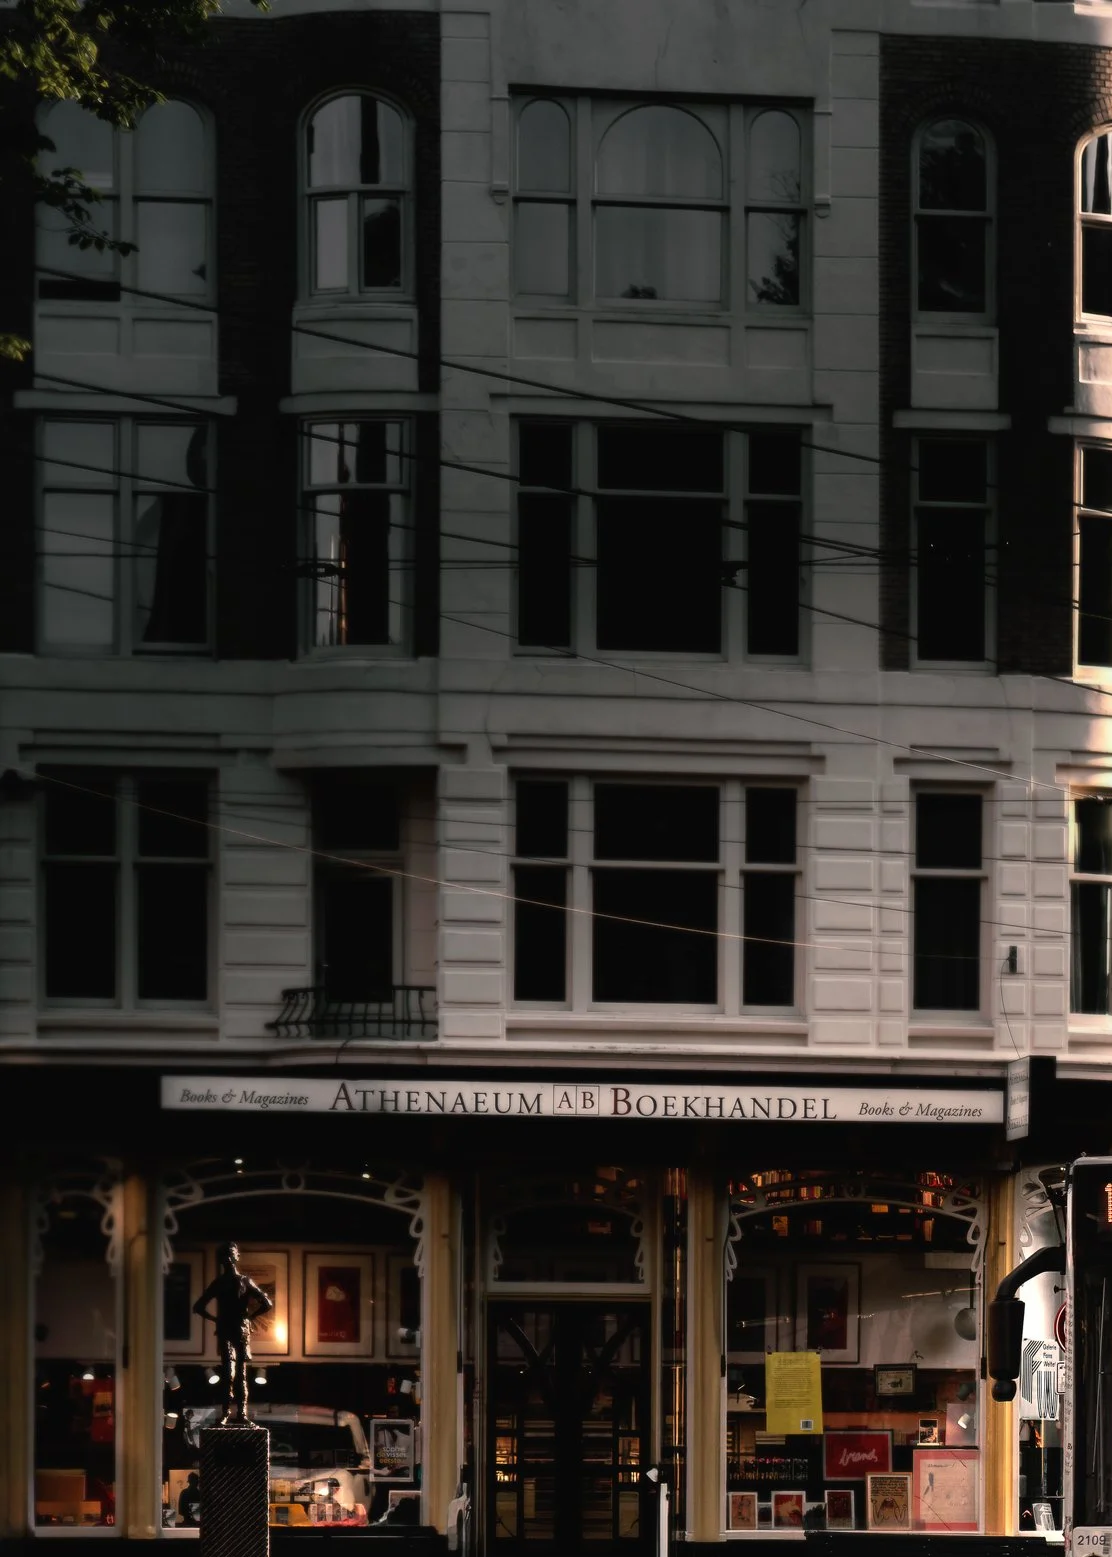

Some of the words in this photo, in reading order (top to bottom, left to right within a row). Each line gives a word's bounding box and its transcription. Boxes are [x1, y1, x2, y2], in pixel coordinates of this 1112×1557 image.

[179, 1088, 218, 1104] Books
[221, 1088, 237, 1104] &
[239, 1090, 309, 1109] Magazines
[328, 1081, 544, 1115] ATHENAEUM
[610, 1086, 838, 1120] BOEKHANDEL
[858, 1101, 895, 1117] Books
[898, 1101, 913, 1117] &
[915, 1102, 983, 1121] Magazines
[1077, 1535, 1106, 1546] 2109
